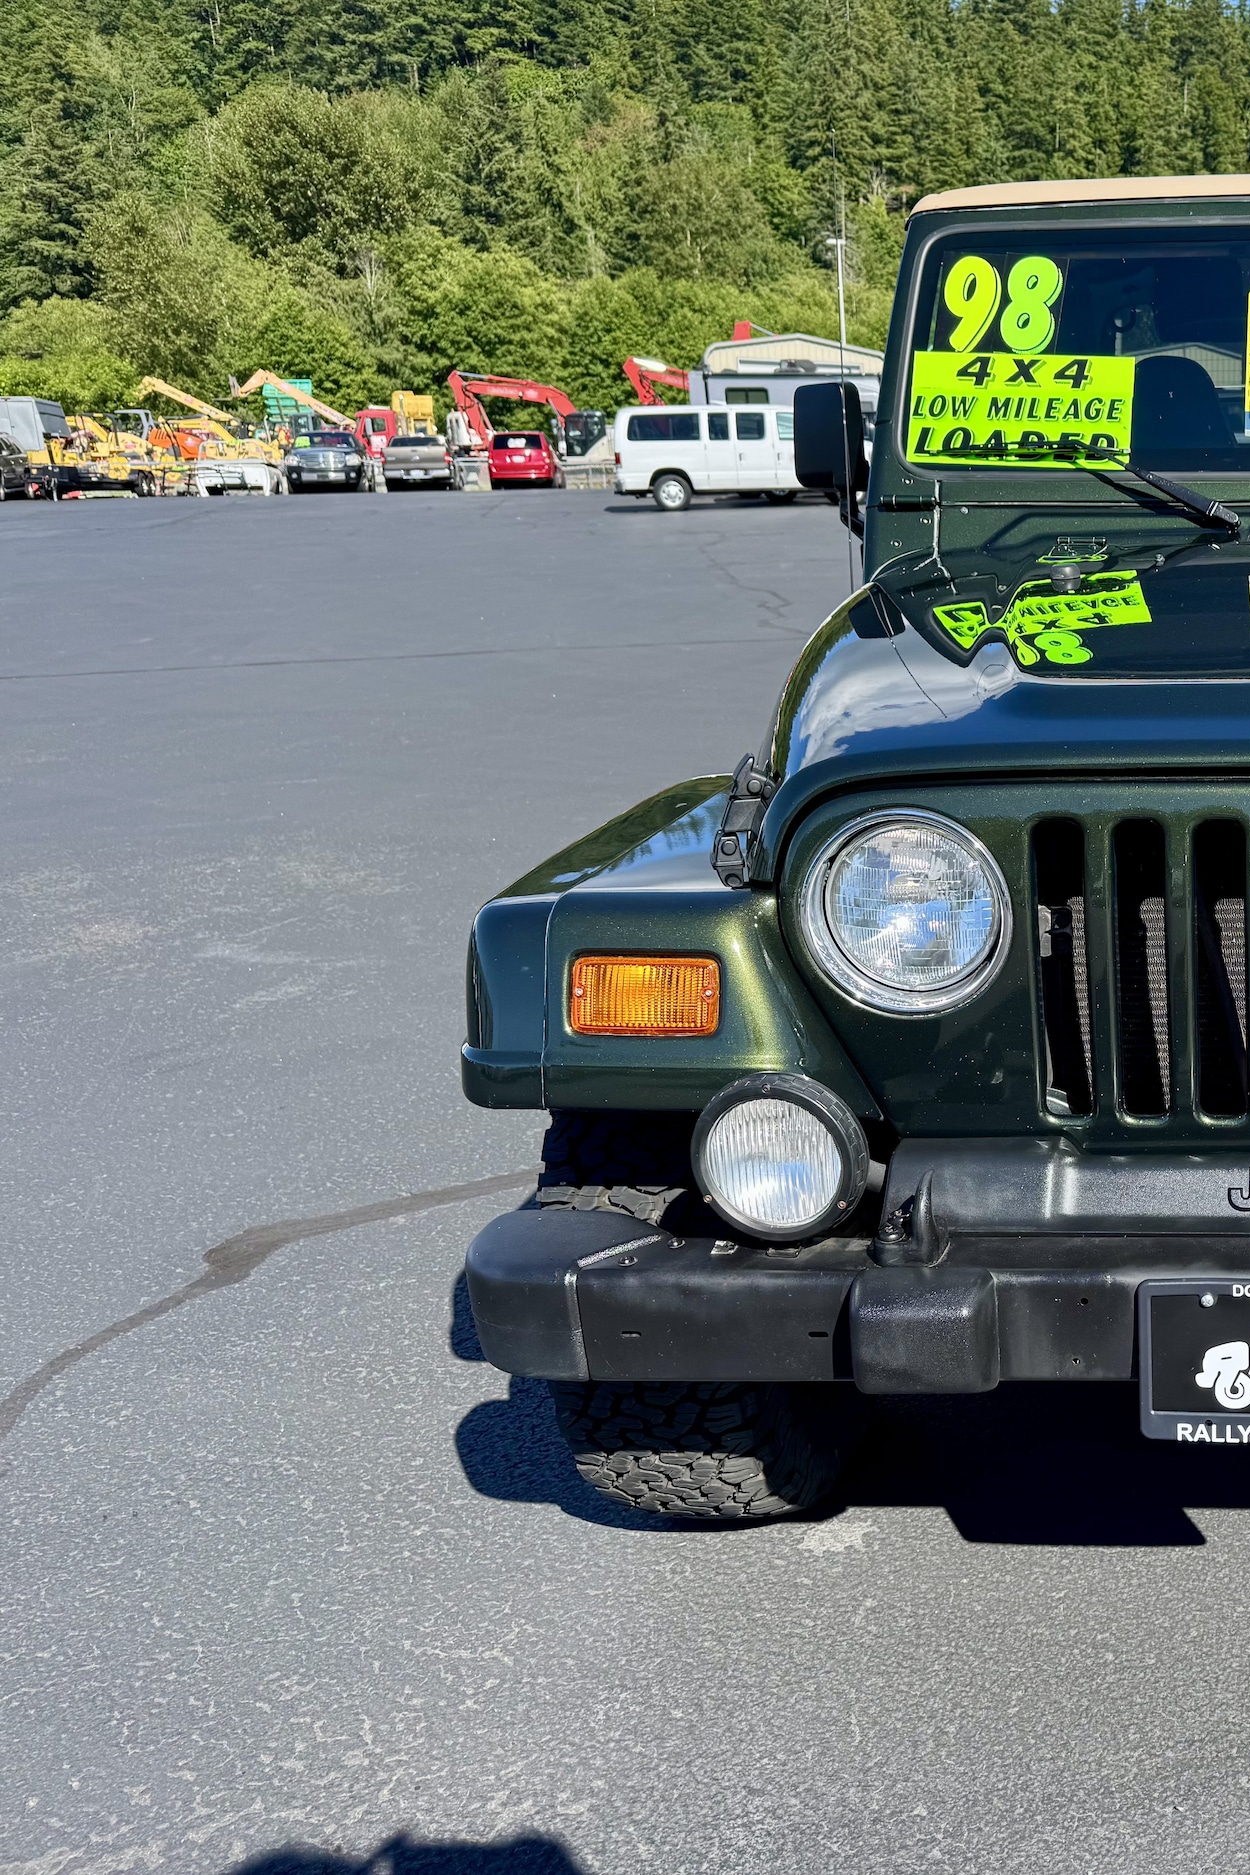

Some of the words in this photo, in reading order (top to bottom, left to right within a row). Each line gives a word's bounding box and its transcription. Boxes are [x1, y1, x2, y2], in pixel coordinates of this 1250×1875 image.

[944, 255, 1064, 354] 98
[912, 395, 977, 420] LOW
[987, 396, 1124, 423] MILEAGE
